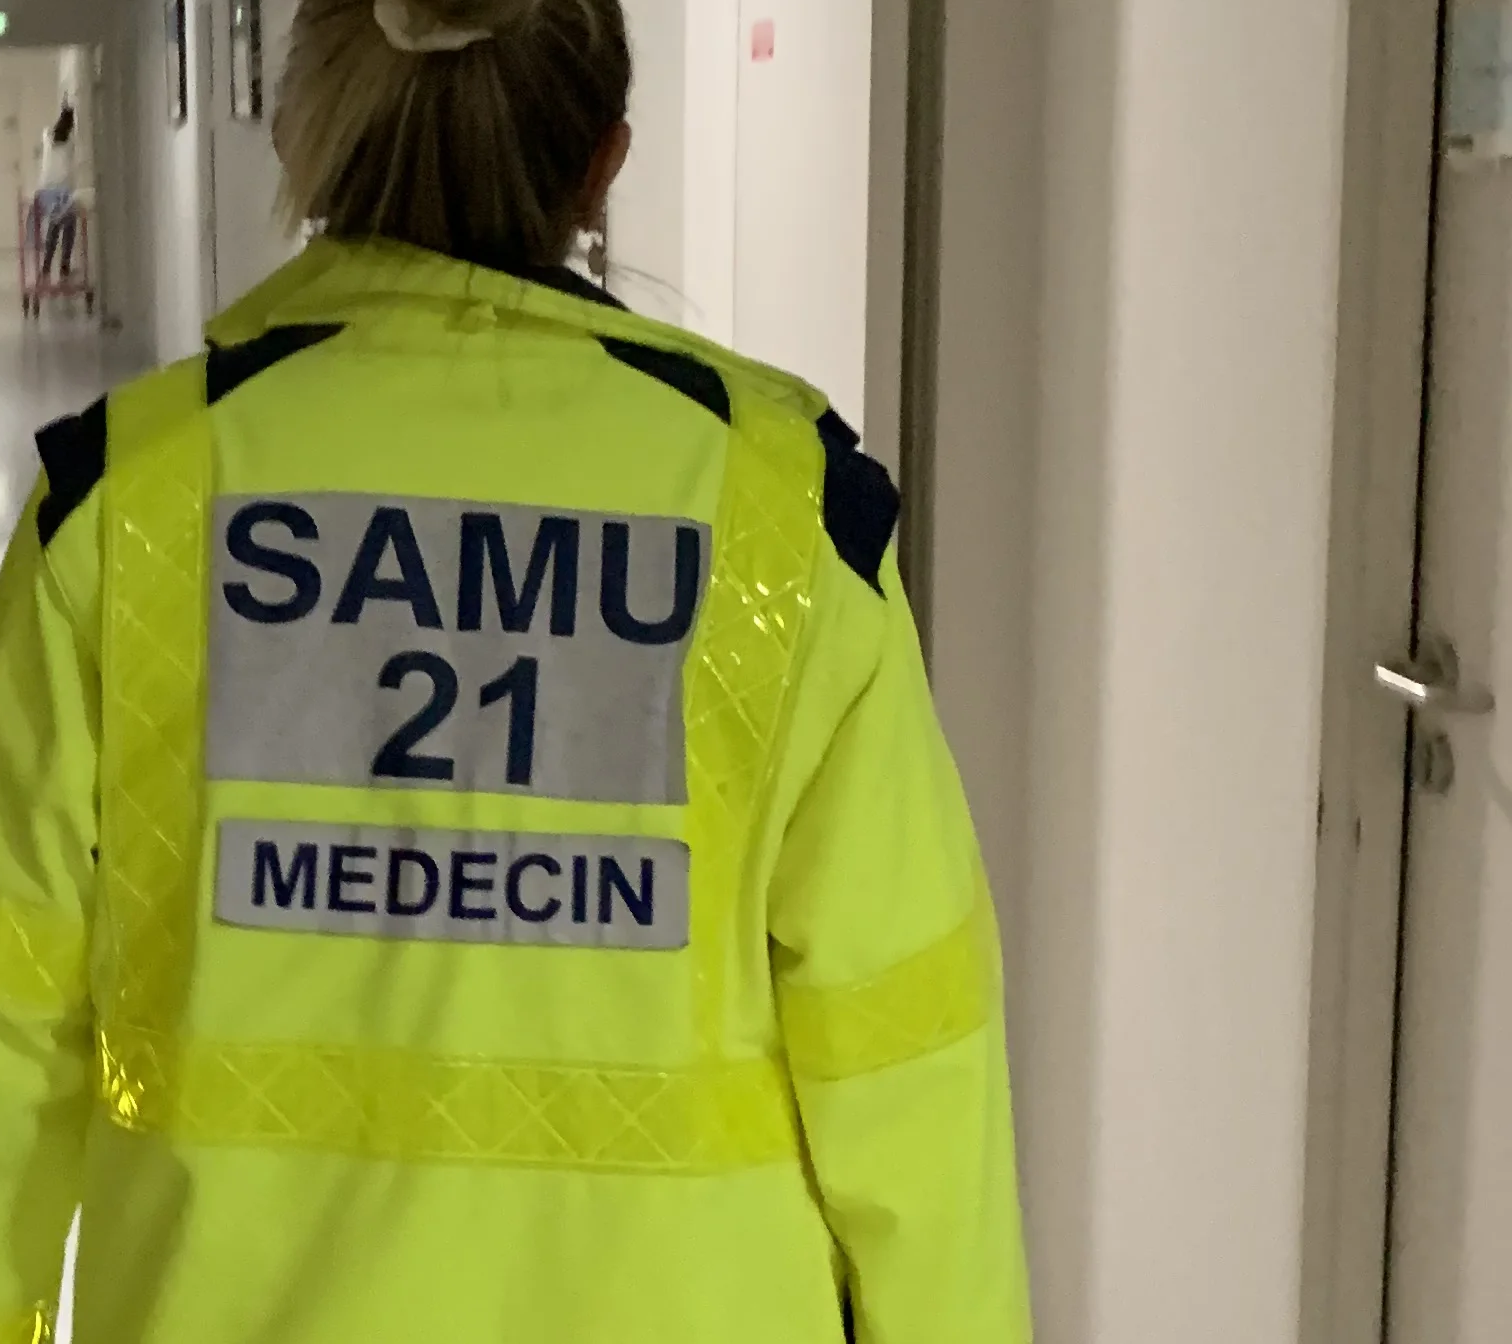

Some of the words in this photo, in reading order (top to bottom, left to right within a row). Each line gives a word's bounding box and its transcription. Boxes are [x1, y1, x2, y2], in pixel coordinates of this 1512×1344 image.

[222, 501, 701, 645] SAMU
[370, 650, 539, 786] 21
[250, 839, 655, 926] MEDECIN
